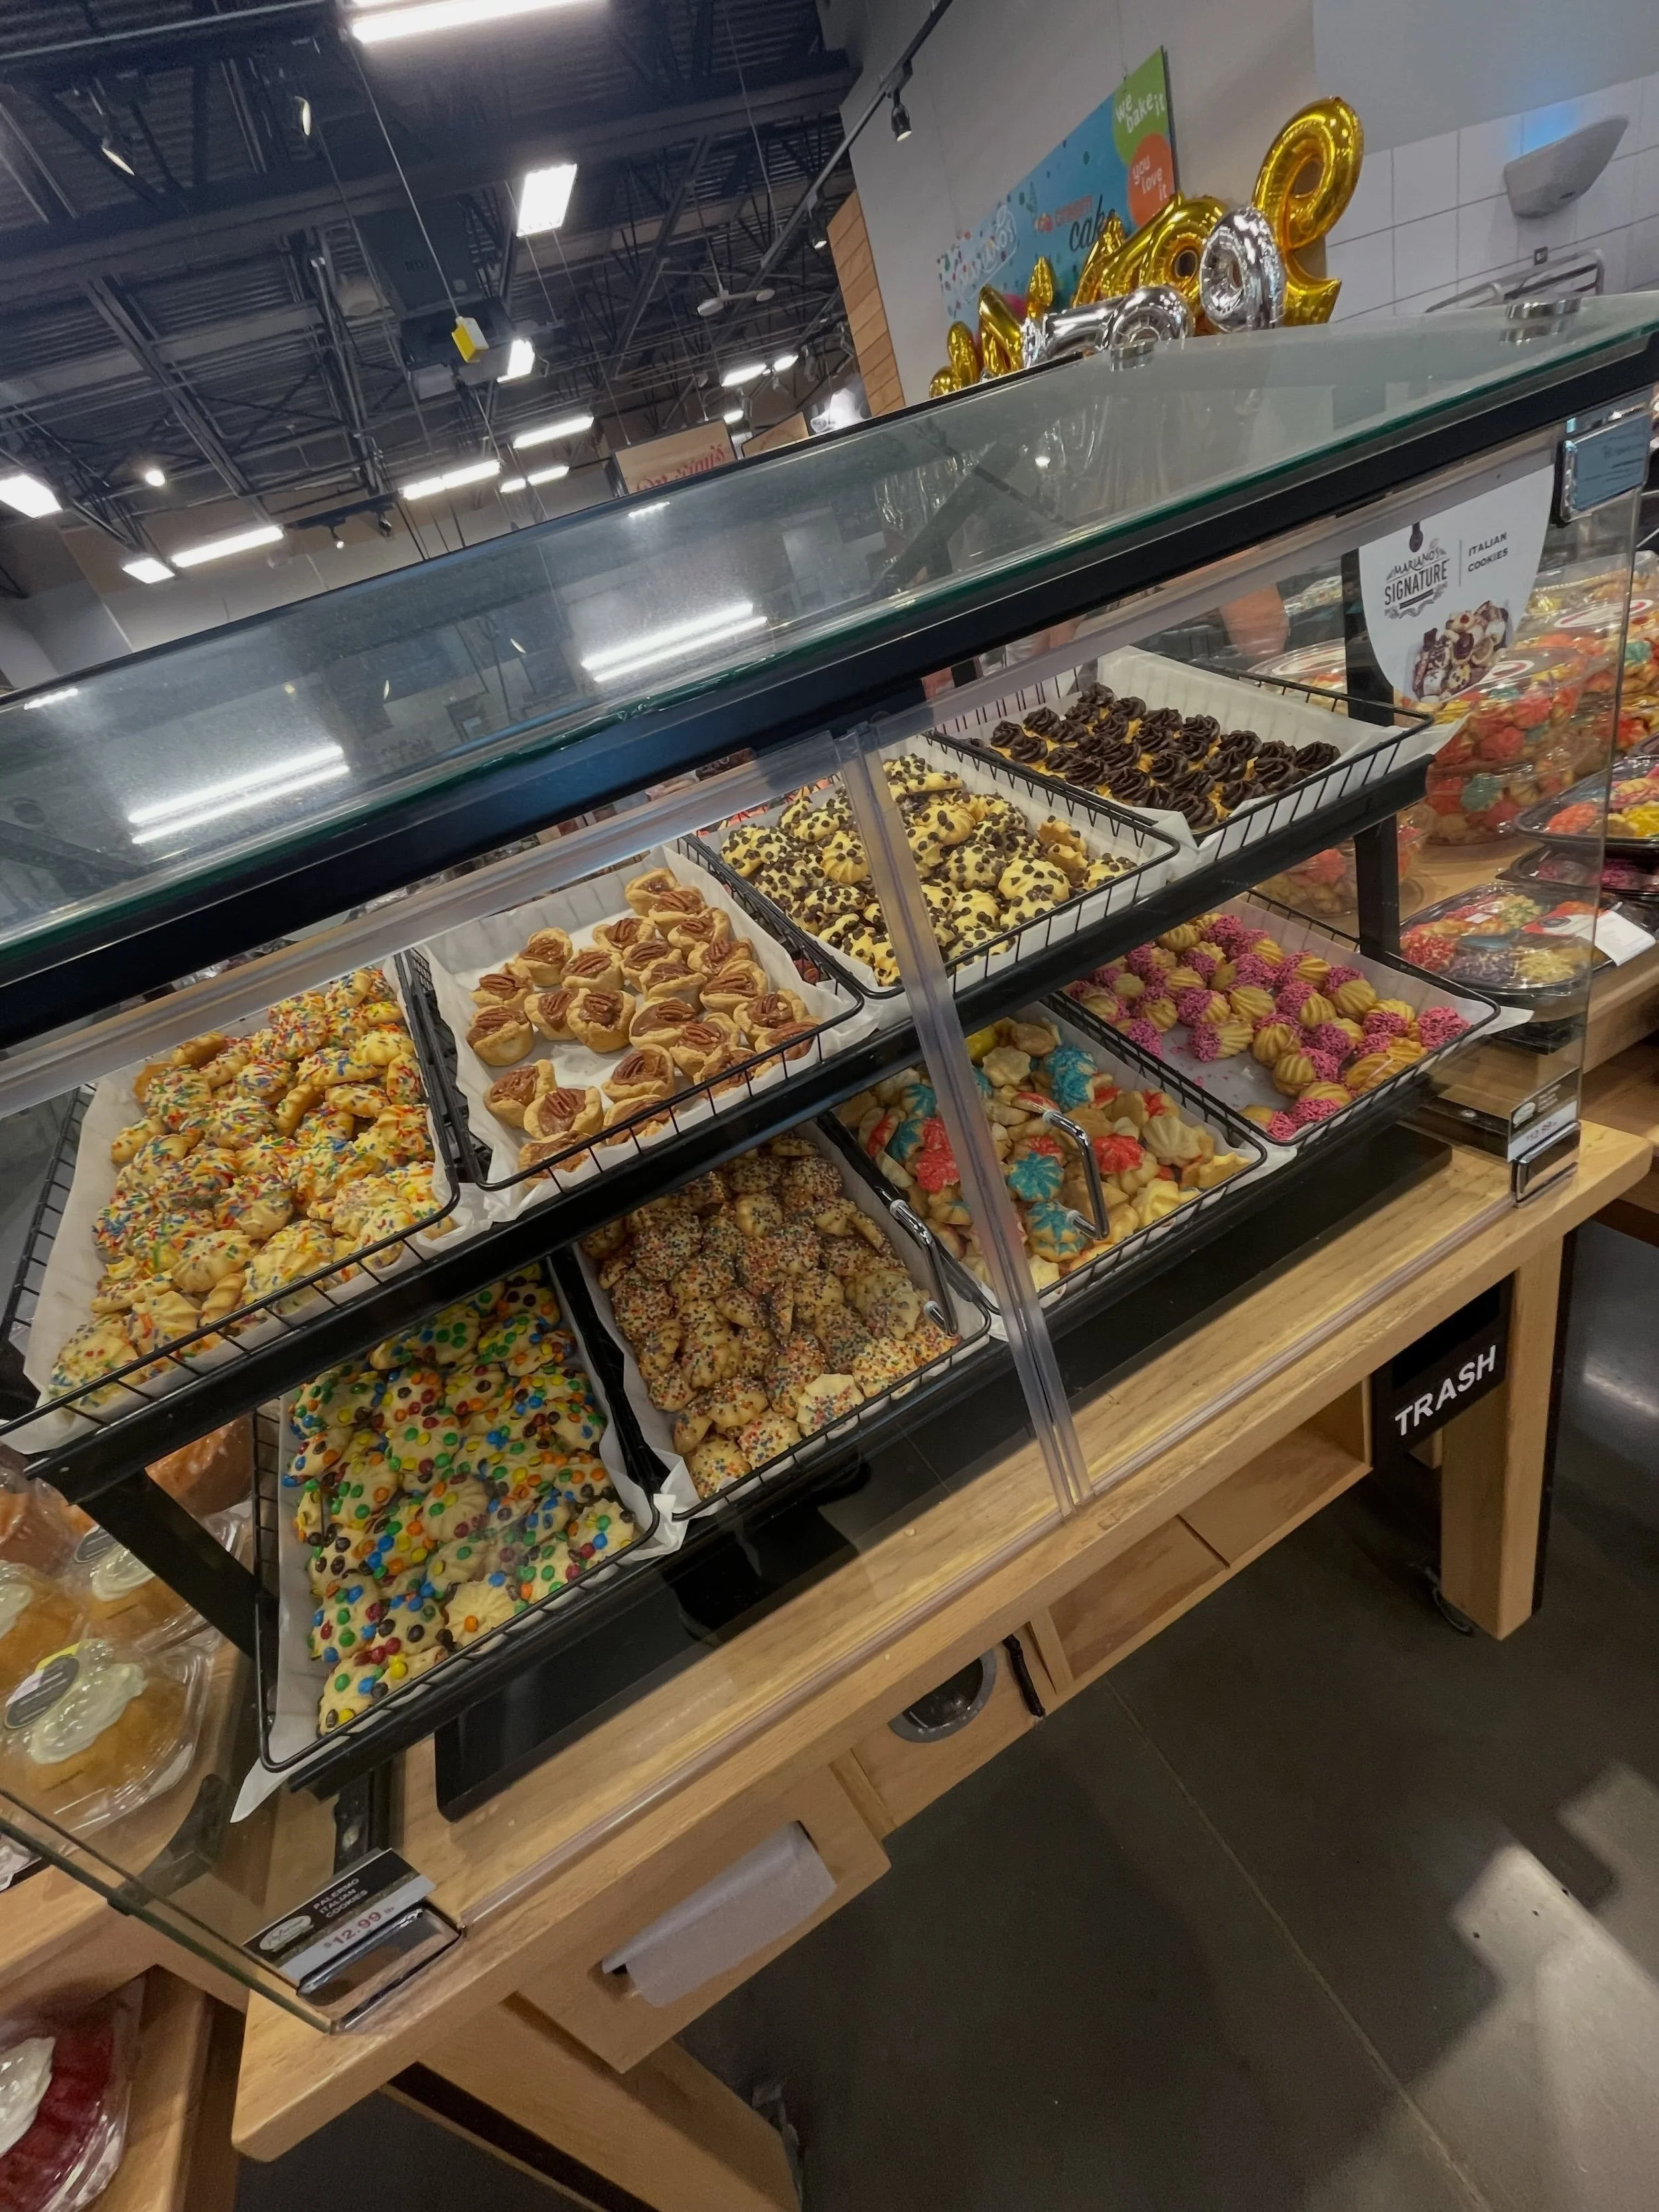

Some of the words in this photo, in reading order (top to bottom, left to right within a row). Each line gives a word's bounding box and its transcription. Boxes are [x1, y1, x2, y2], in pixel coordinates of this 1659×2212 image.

[1115, 94, 1133, 123] we
[1125, 93, 1153, 133] bake
[1153, 92, 1166, 117] it
[1132, 155, 1151, 185] you
[1141, 167, 1163, 194] love
[1159, 183, 1168, 202] it
[1069, 193, 1116, 252] cak
[1469, 532, 1508, 556] ITALIAN
[1468, 548, 1508, 572] COOKIES
[1384, 558, 1451, 605] SIGNATURE
[1395, 1345, 1496, 1436] TRASH
[319, 1889, 356, 1913] ITALIAN
[326, 1889, 368, 1917] COOKIES
